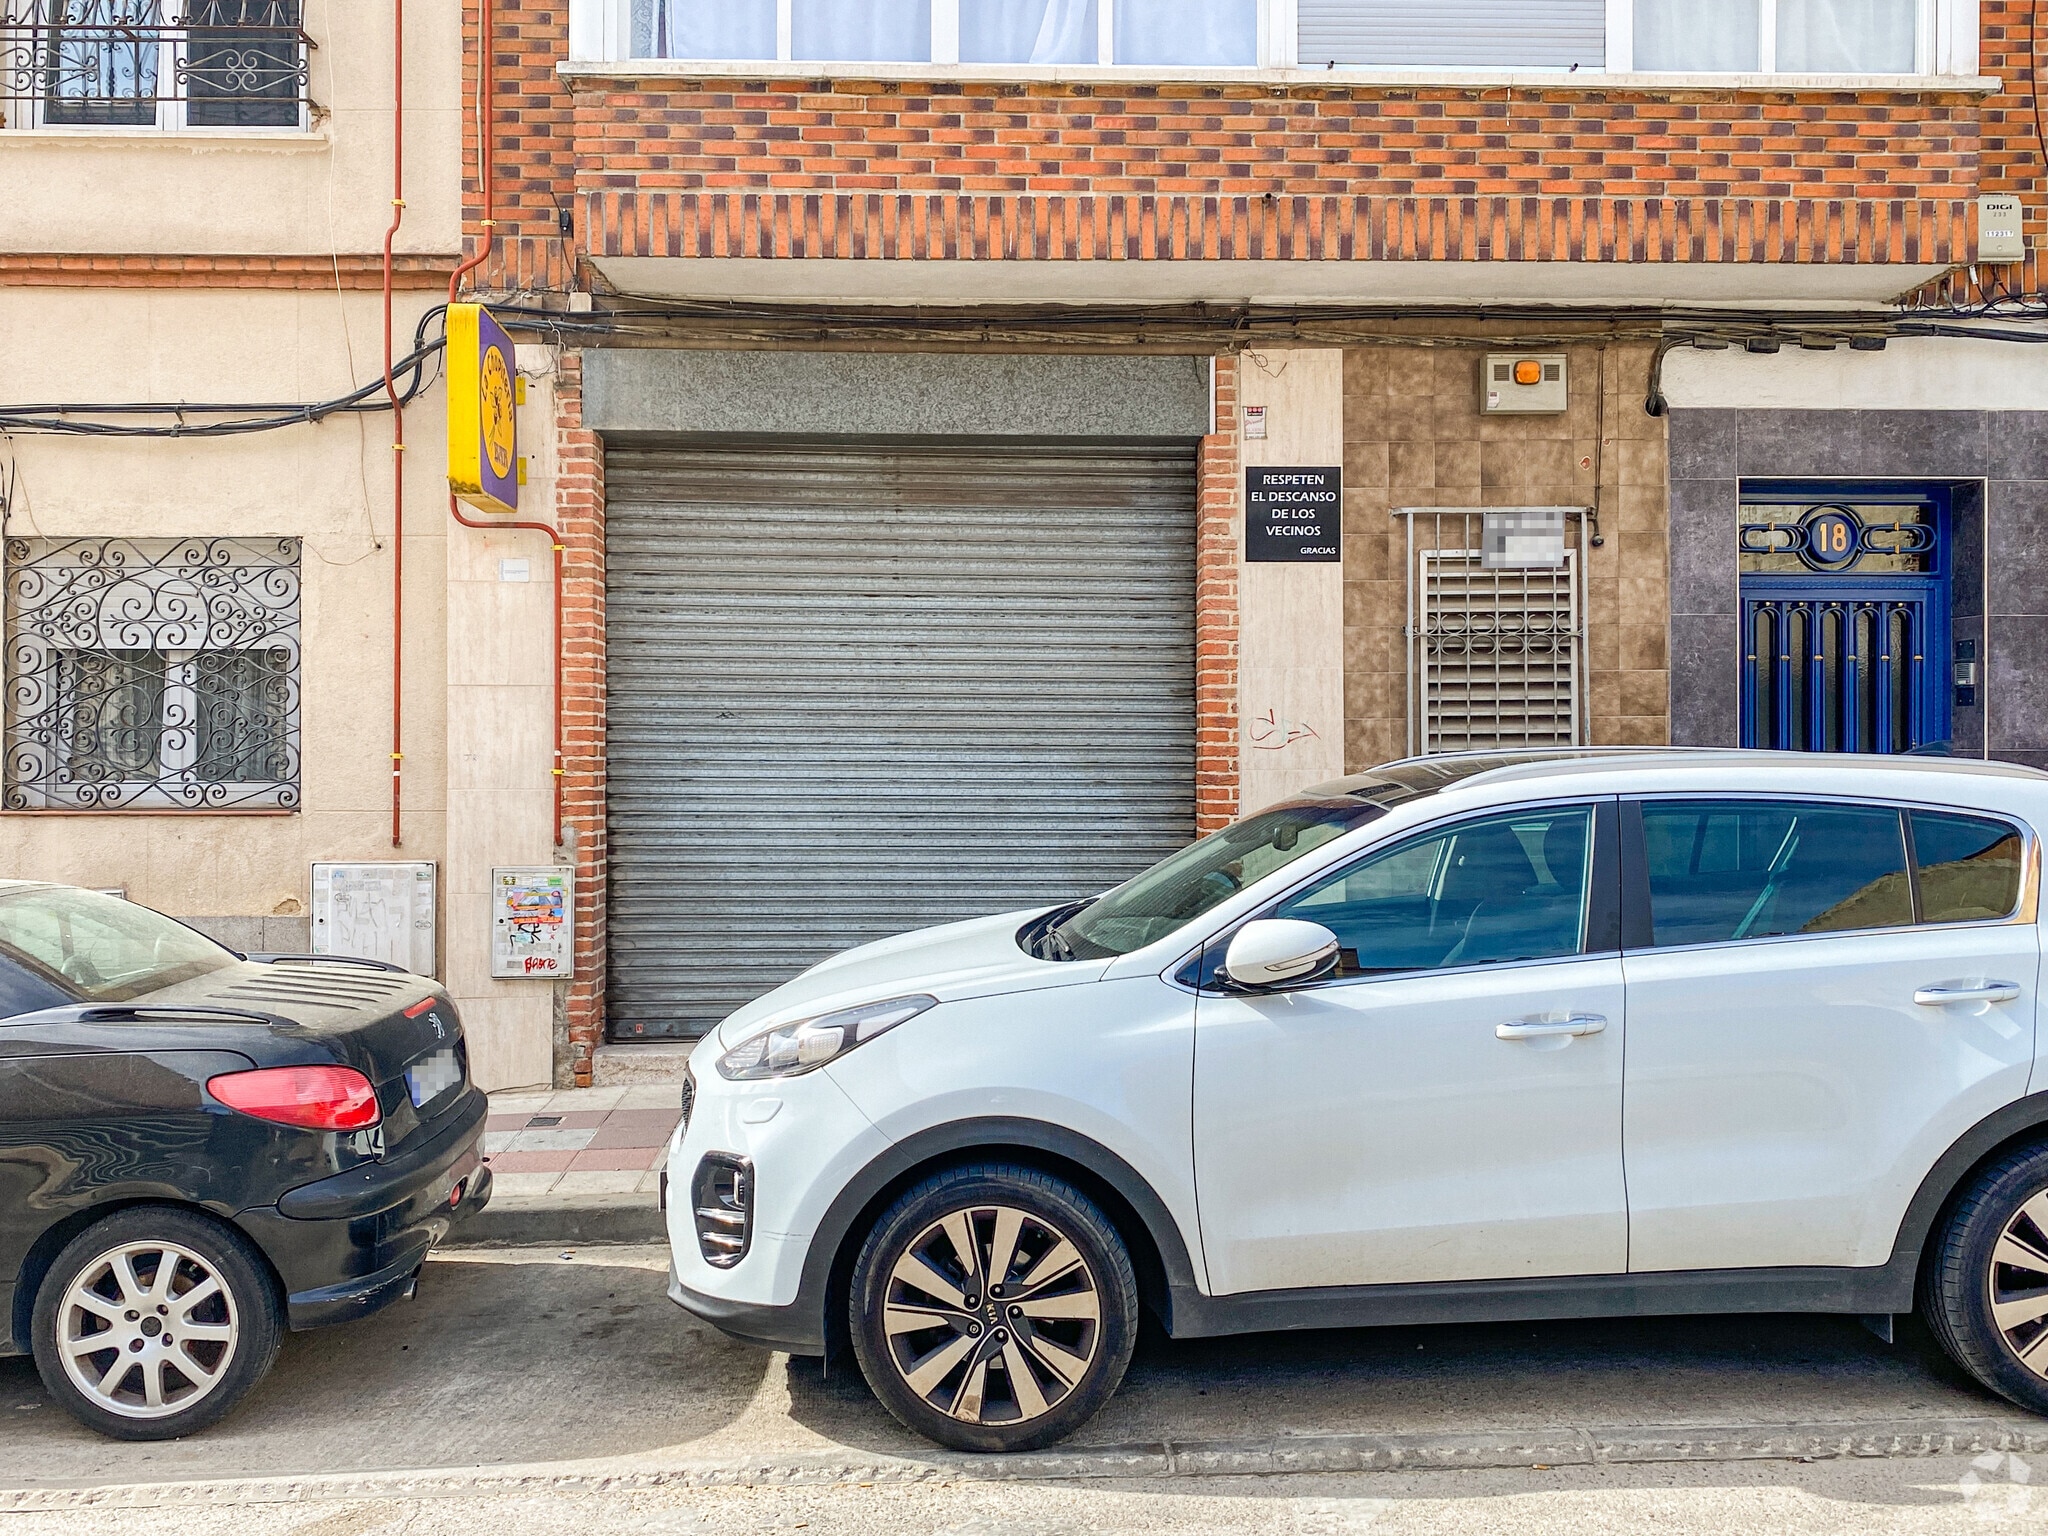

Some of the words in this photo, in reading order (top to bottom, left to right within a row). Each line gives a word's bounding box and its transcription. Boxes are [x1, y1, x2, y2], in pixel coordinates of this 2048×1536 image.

[1262, 474, 1325, 485] RESPETEN
[1251, 491, 1266, 502] EL
[1268, 491, 1337, 502] DESCANSO
[1271, 508, 1289, 519] DE
[1291, 508, 1316, 519] LOS
[1265, 525, 1321, 536] VECINOS
[1819, 522, 1847, 552] 18
[1300, 546, 1337, 555] GRACIAS
[985, 1302, 999, 1325] KIA
